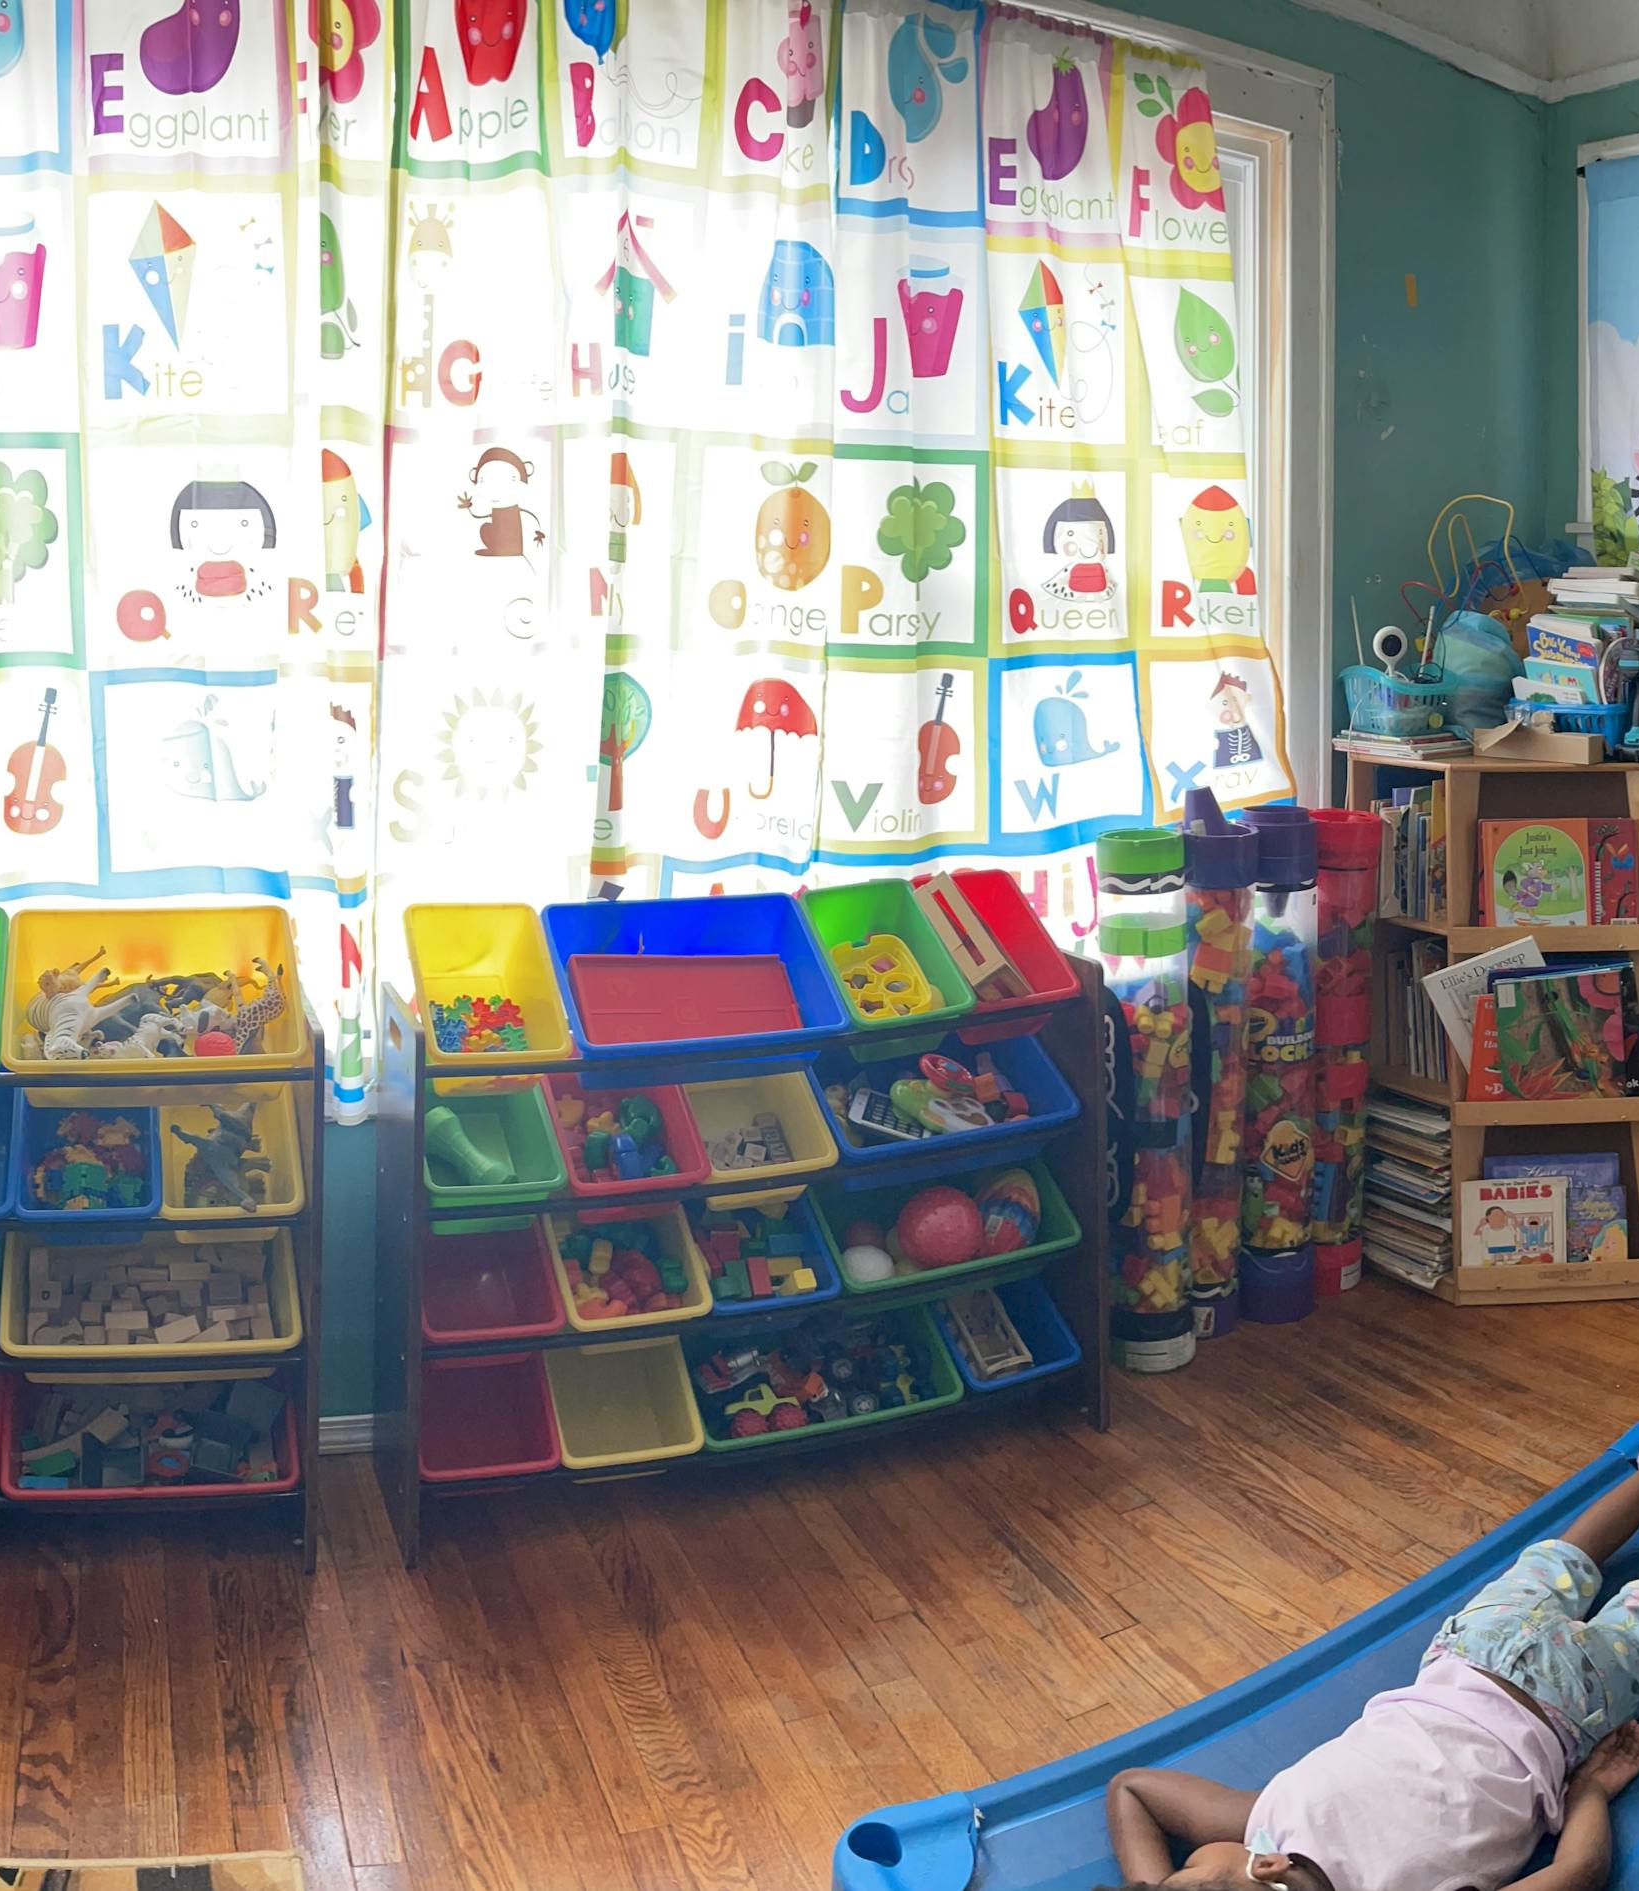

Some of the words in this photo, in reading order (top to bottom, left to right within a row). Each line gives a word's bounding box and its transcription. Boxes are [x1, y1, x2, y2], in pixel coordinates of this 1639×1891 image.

[89, 52, 270, 150] Eggplant
[410, 45, 530, 147] Apple
[103, 323, 204, 400] Kite
[997, 360, 1076, 430] Kite
[1439, 971, 1472, 990] Ellie's
